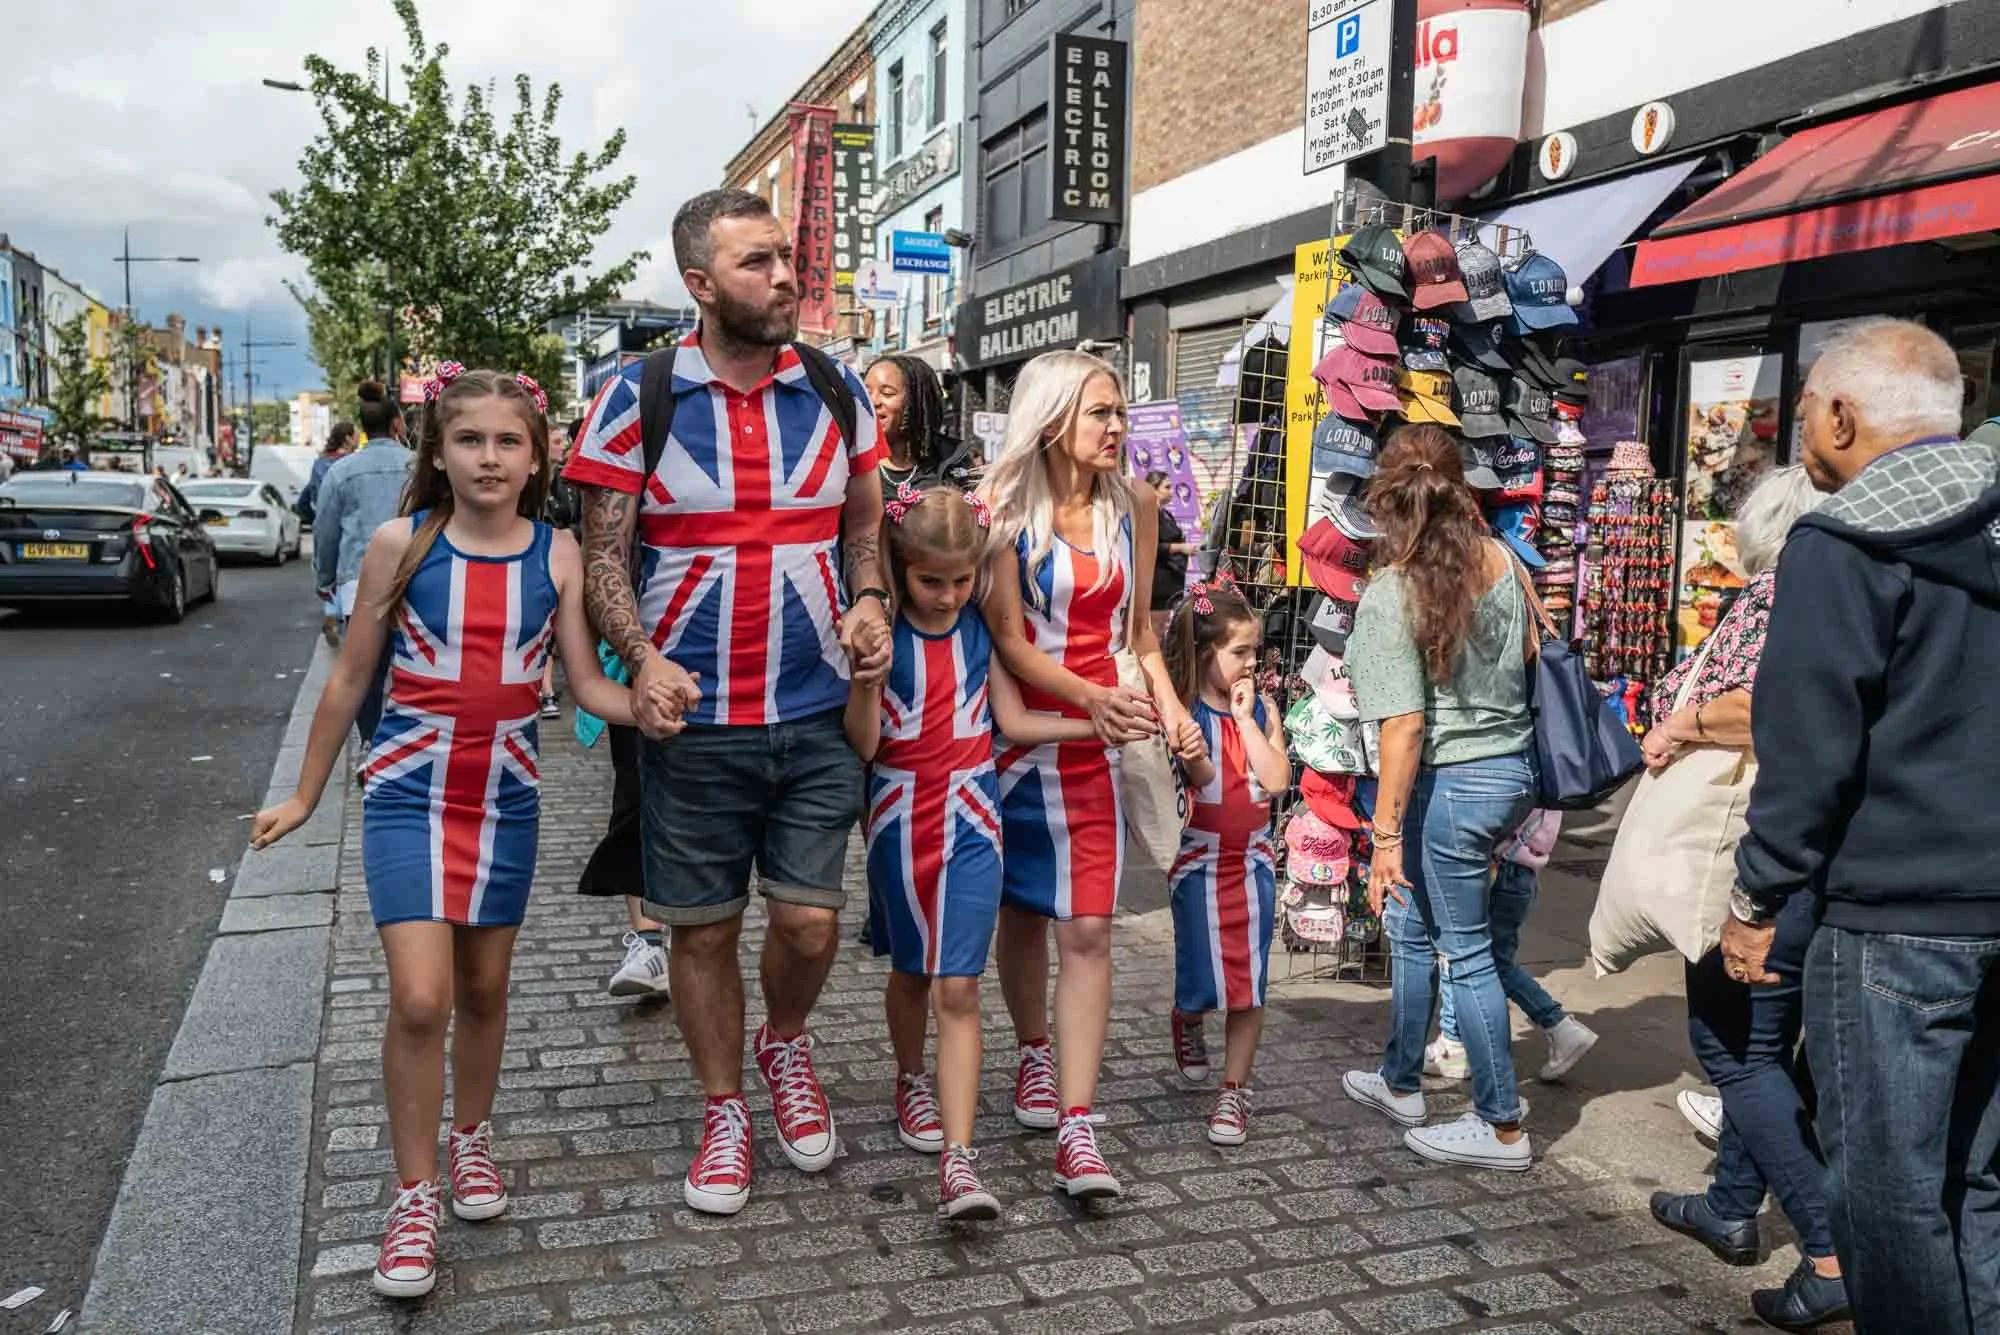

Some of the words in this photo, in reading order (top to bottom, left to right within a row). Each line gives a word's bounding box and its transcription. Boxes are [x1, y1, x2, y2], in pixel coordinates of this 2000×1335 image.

[1312, 3, 1332, 21] 8.30
[1341, 20, 1357, 54] P
[1311, 83, 1342, 103] M'night
[1347, 71, 1369, 89] 8.30
[1370, 67, 1384, 80] am
[1329, 65, 1347, 80] Mon
[1353, 56, 1365, 70] Fri
[1310, 101, 1330, 118] 6.30
[1331, 97, 1344, 111] pm
[1350, 82, 1383, 102] M'night
[1063, 47, 1083, 206] ELECTRIC
[1089, 51, 1112, 208] BALLROOM
[1323, 115, 1339, 131] Sat
[1309, 130, 1340, 151] M'night
[1315, 152, 1322, 163] 6
[1322, 149, 1335, 163] pm
[1341, 134, 1373, 155] M'night
[833, 151, 851, 269] TATTOO
[895, 256, 948, 269] EXCHANGE
[984, 274, 1073, 326] ELECTRIC
[979, 310, 1079, 361] BALLROOM
[1494, 445, 1536, 469] London
